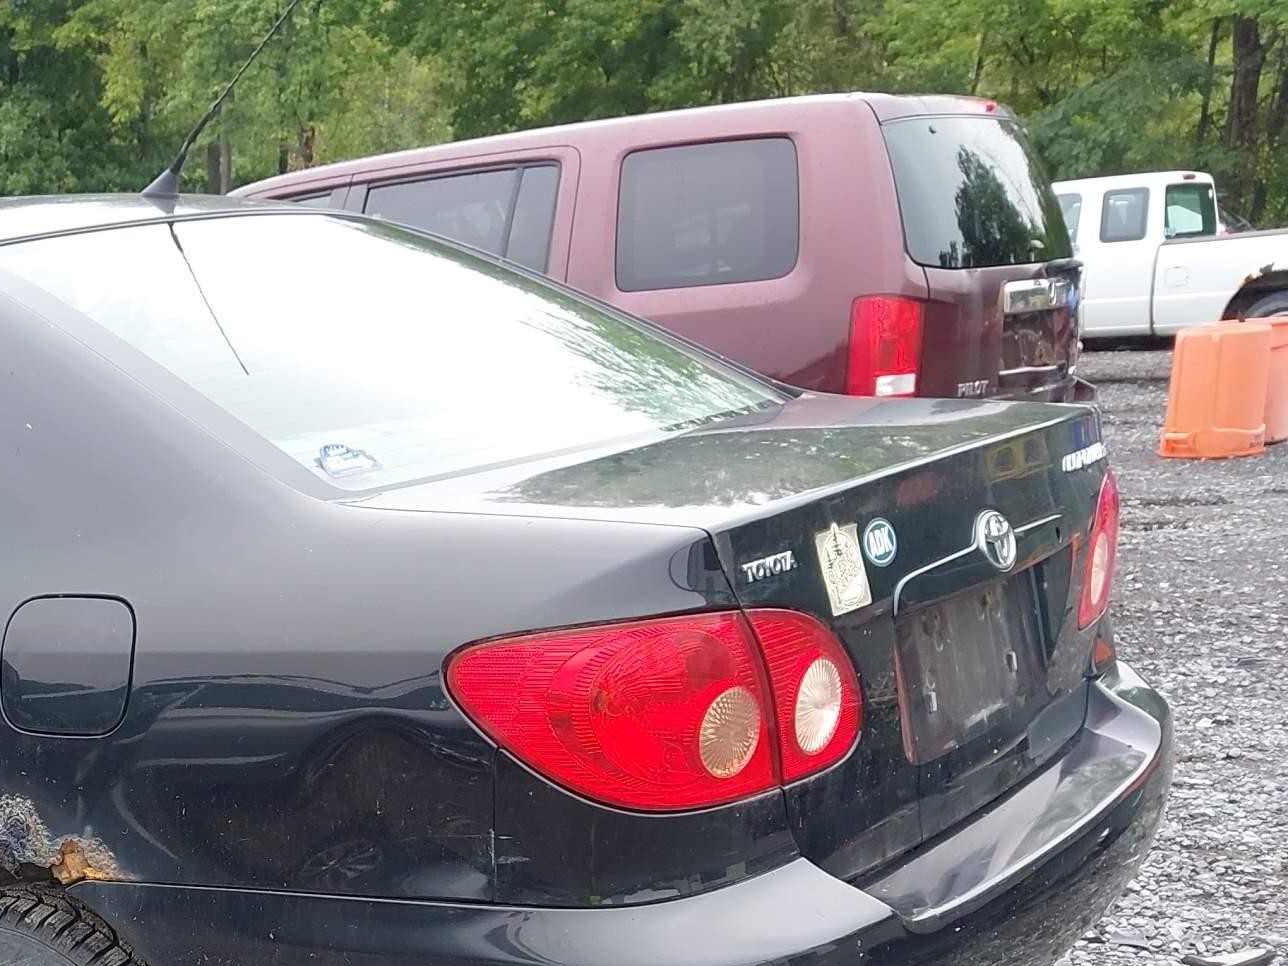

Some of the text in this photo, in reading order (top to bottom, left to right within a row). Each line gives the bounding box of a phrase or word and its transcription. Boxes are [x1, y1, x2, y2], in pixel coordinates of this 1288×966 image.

[957, 380, 989, 397] PILOT
[868, 526, 893, 558] ADK
[741, 550, 799, 583] TOYOTA
